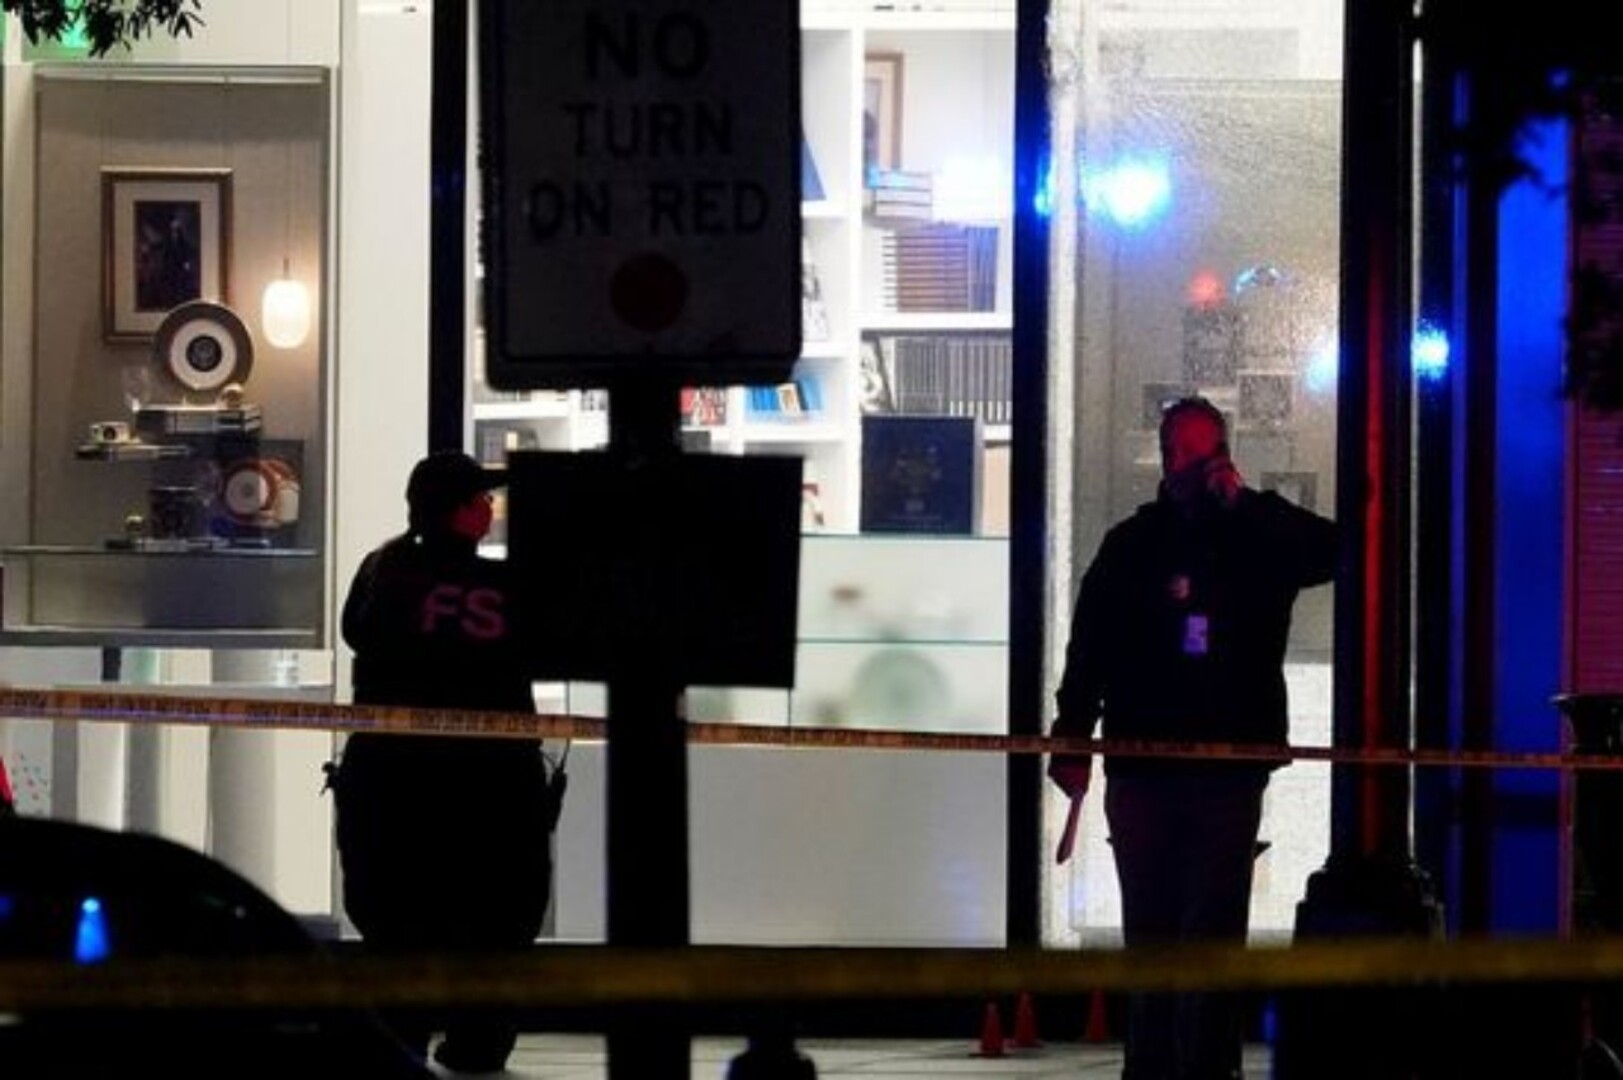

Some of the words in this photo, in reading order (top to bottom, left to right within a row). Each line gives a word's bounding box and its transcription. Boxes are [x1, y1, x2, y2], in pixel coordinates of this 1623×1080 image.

[584, 11, 709, 79] NO
[562, 101, 732, 157] TURN
[528, 180, 613, 240] ON
[650, 180, 769, 236] RED
[419, 584, 507, 640] FS
